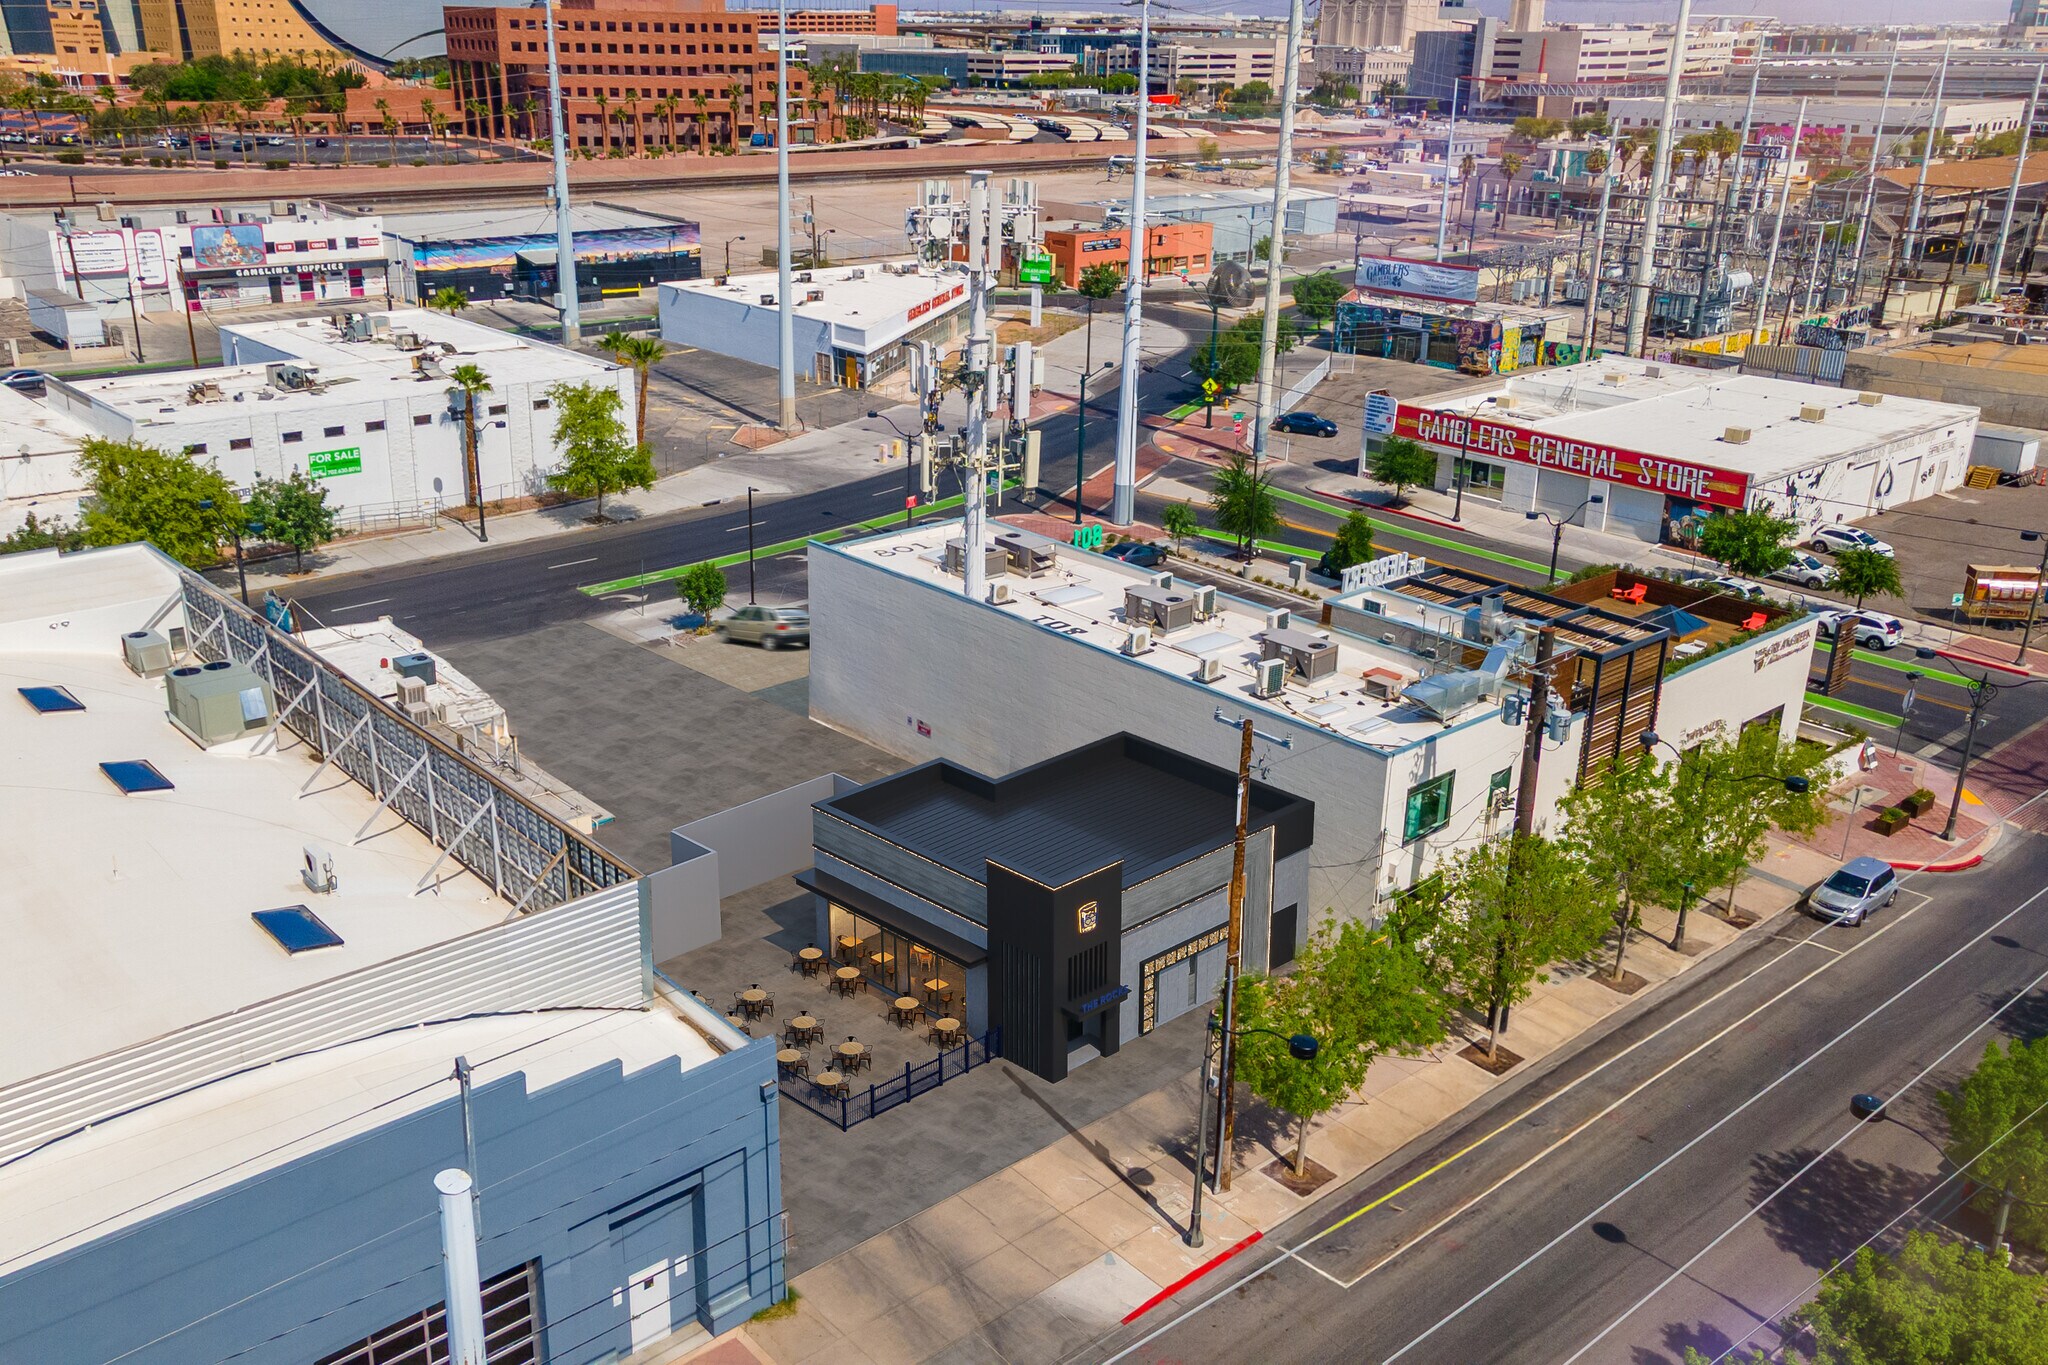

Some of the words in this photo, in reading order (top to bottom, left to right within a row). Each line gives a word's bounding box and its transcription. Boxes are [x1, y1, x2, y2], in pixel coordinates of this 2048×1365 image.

[1763, 148, 1781, 157] 629
[235, 266, 290, 277] GAMBLING
[296, 262, 344, 273] SUPPLIES
[1366, 263, 1410, 282] GAMBLERS
[309, 453, 332, 464] FOR
[334, 449, 360, 461] SALE
[1417, 412, 1517, 457] GAMBLERS
[1528, 435, 1622, 479] GENERAL
[1638, 457, 1714, 499] STORE
[873, 542, 933, 557] 801
